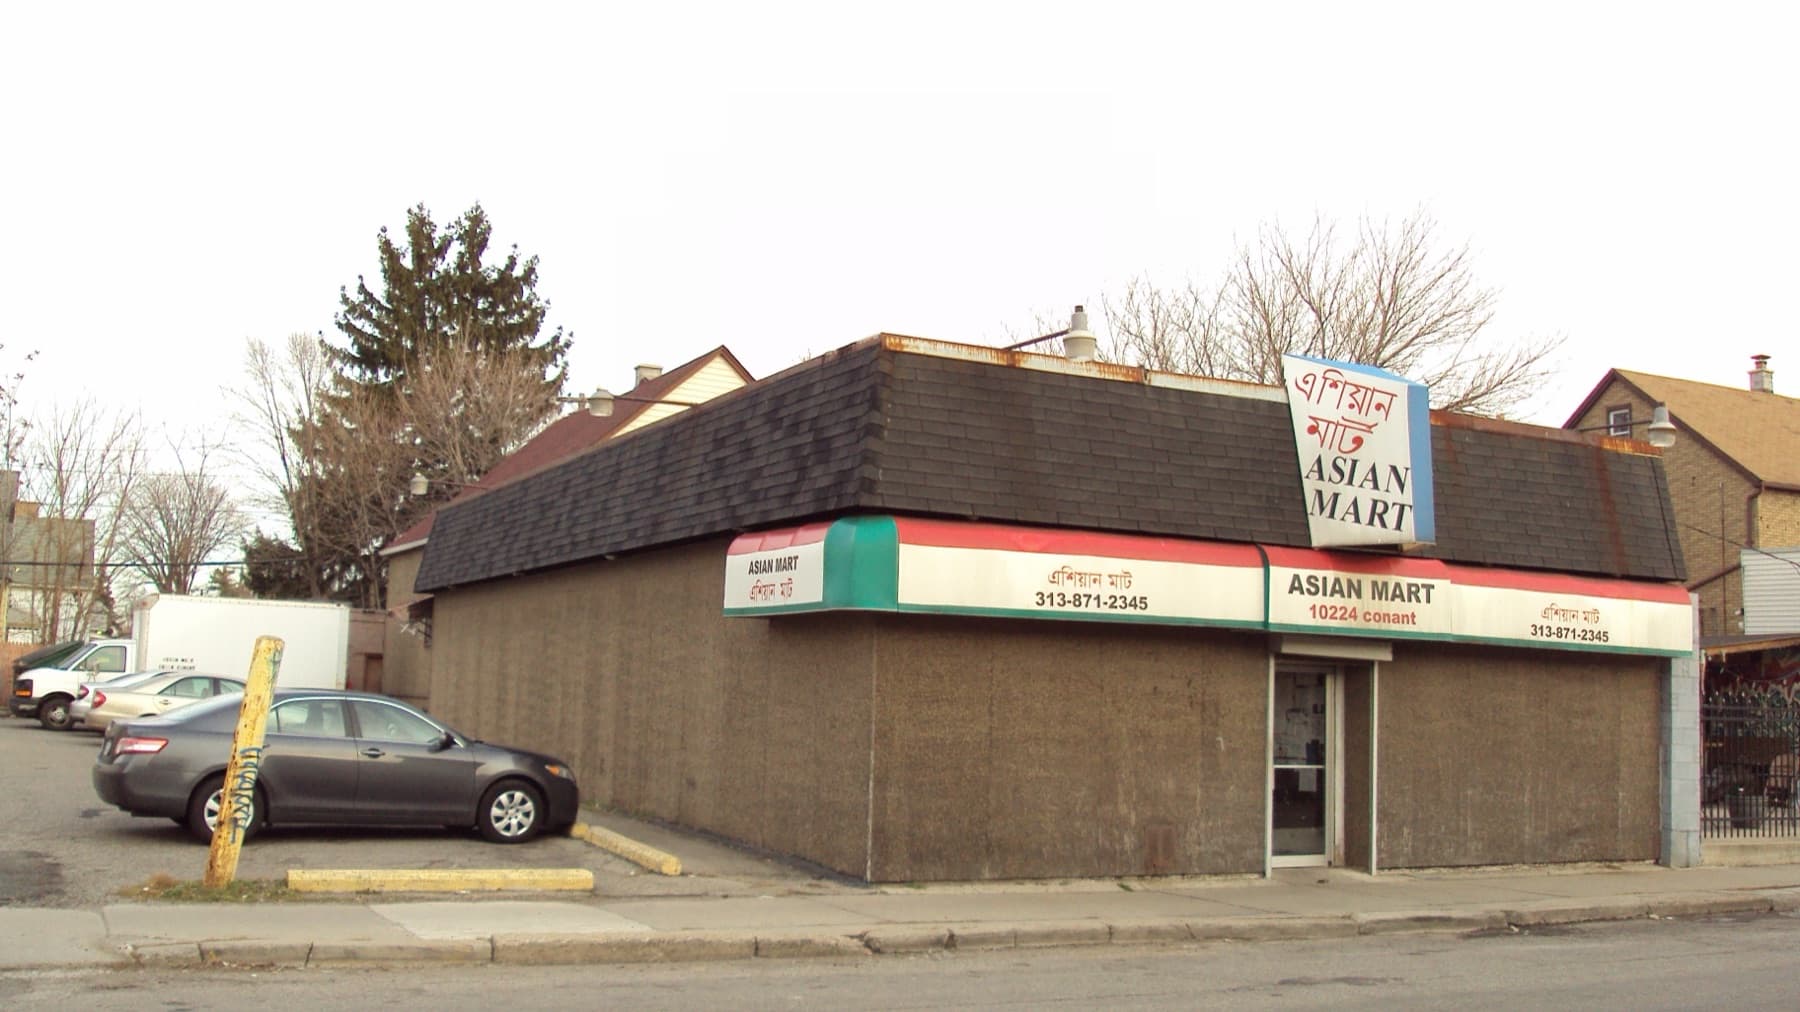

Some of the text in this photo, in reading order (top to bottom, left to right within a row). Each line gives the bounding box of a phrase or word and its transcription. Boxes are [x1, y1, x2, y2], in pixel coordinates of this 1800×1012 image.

[1303, 453, 1411, 496] ASIAN
[1308, 488, 1414, 533] MART
[748, 555, 799, 576] ASIAN MART
[1287, 573, 1435, 605] ASIAN MART
[1035, 591, 1149, 611] 313-871-2345
[1308, 603, 1417, 626] 10224 conant
[1530, 623, 1609, 643] 313-871-2345
